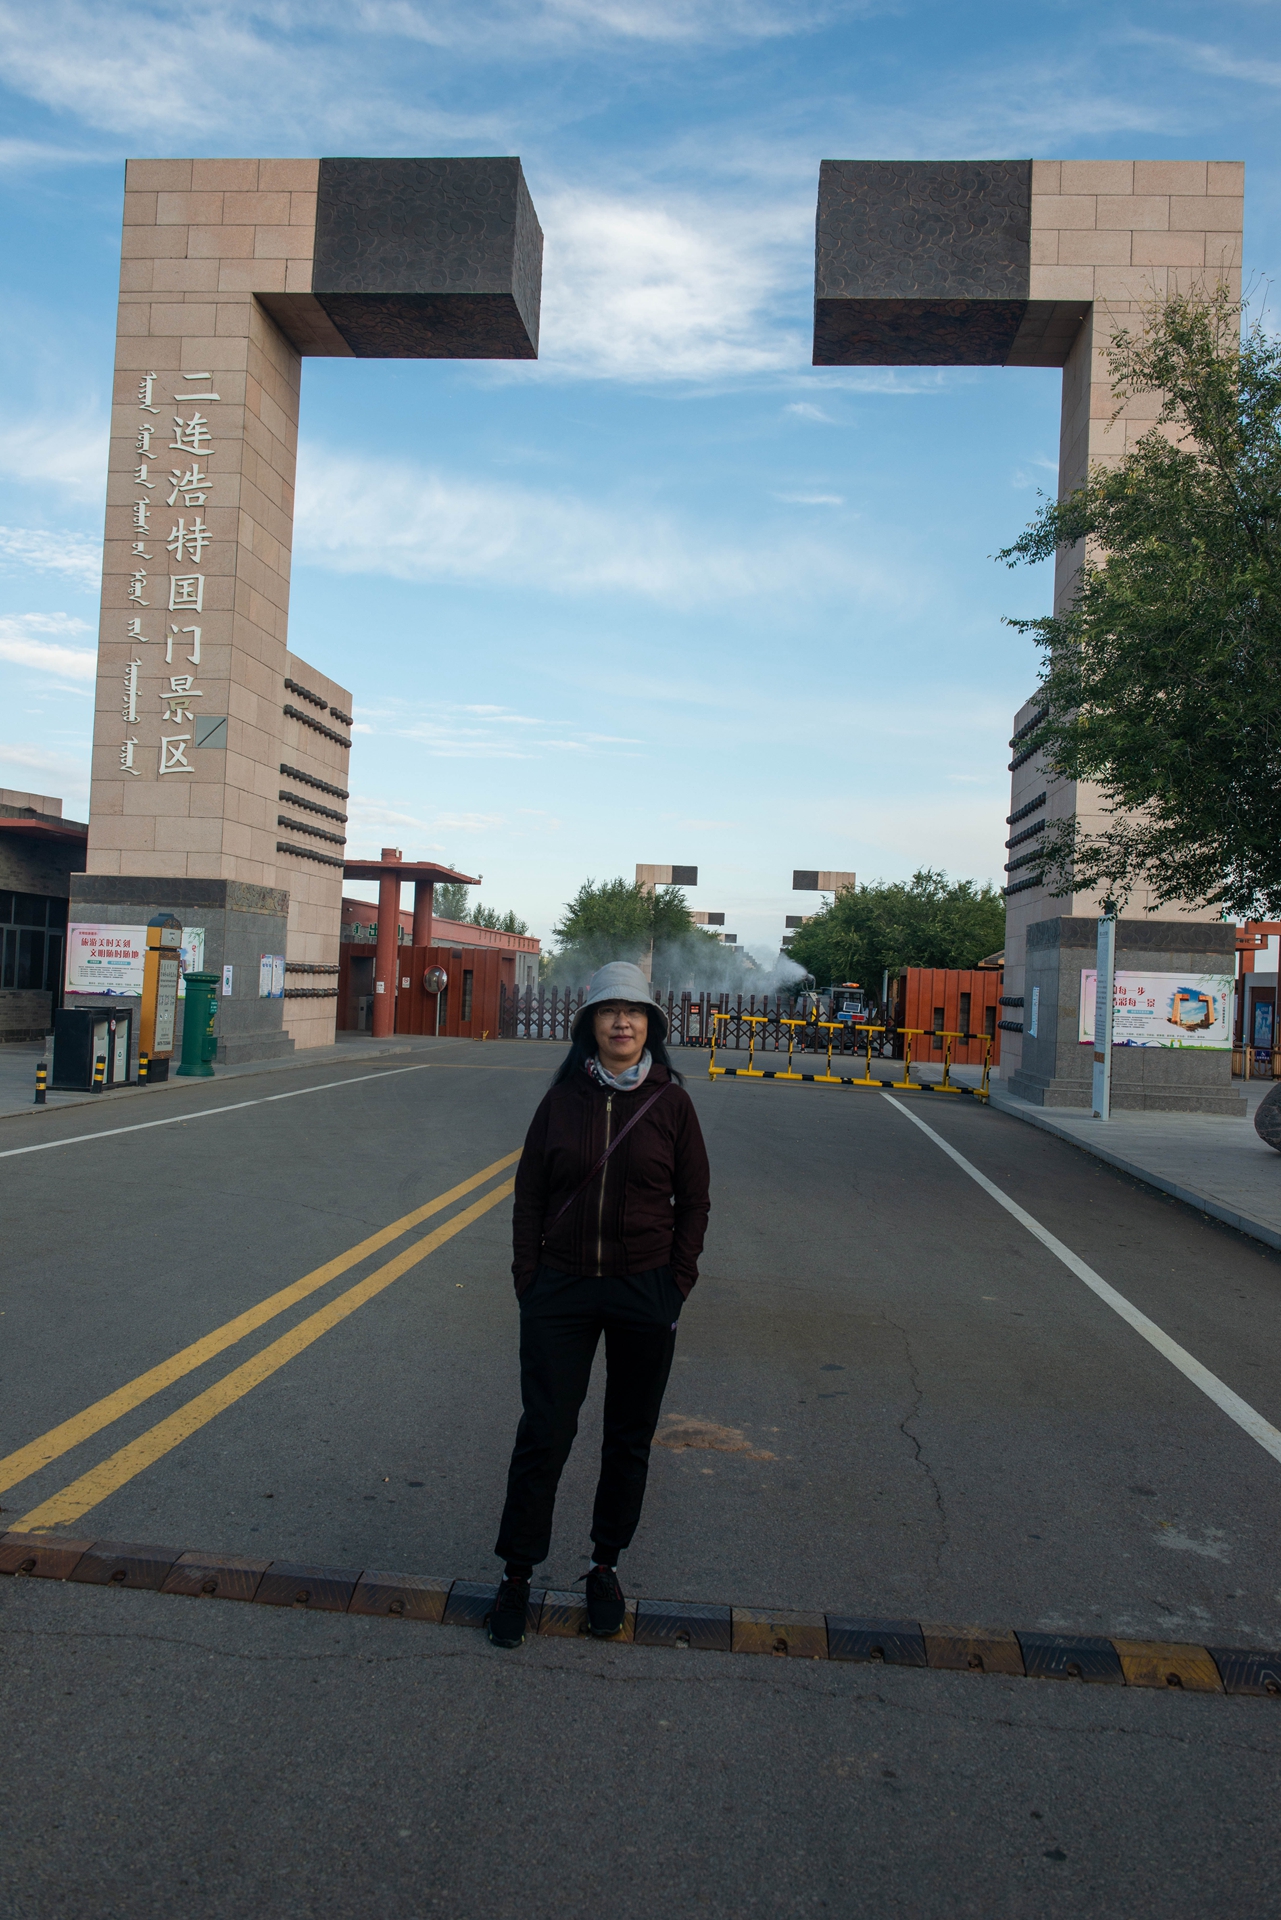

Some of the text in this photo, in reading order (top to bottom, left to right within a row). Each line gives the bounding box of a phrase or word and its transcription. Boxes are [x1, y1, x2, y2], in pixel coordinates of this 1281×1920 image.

[158, 371, 221, 776] 二连浩特国门景区
[90, 948, 139, 959] 文明随时随地
